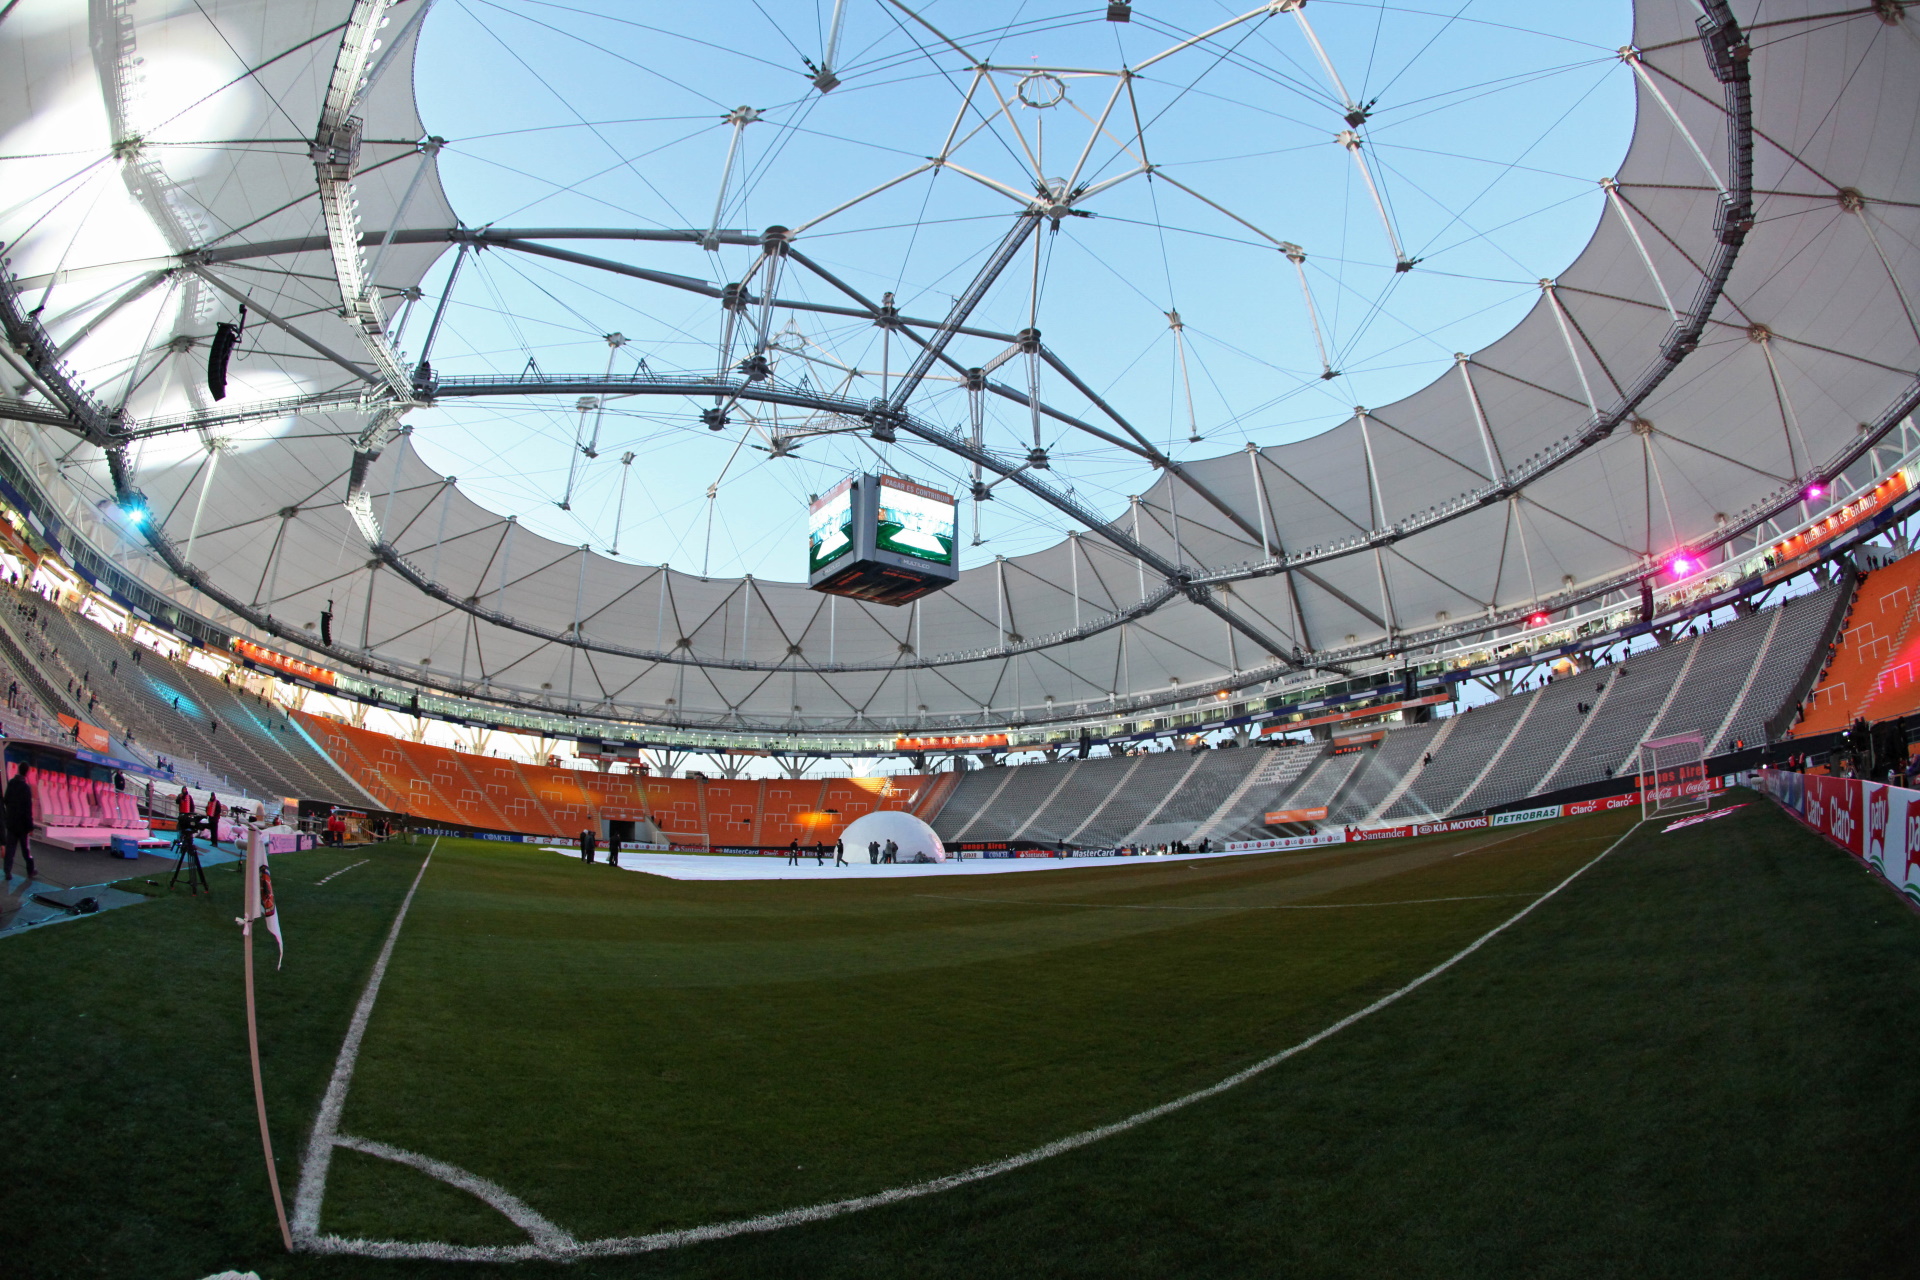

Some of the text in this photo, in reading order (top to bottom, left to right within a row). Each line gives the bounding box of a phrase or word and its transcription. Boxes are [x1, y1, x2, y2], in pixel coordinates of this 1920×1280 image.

[885, 478, 950, 503] PAGAR ES CONTRIBUIR
[1803, 523, 1827, 545] BUENOS
[1849, 492, 1878, 517] GRANDE
[1570, 803, 1593, 815] Claro
[1606, 797, 1629, 809] Claro
[1806, 790, 1821, 827] Claro
[1496, 808, 1556, 824] PETROBRAS
[1830, 795, 1850, 845] Claro
[1871, 795, 1887, 838] paty
[1433, 817, 1487, 832] KIA MOTORS
[422, 828, 460, 838] TRAFFIC
[1362, 829, 1406, 841] Santander
[723, 847, 759, 855] MasterCard
[961, 842, 984, 850] uenos
[1024, 850, 1049, 858] Santander
[1072, 848, 1115, 858] MasterCard
